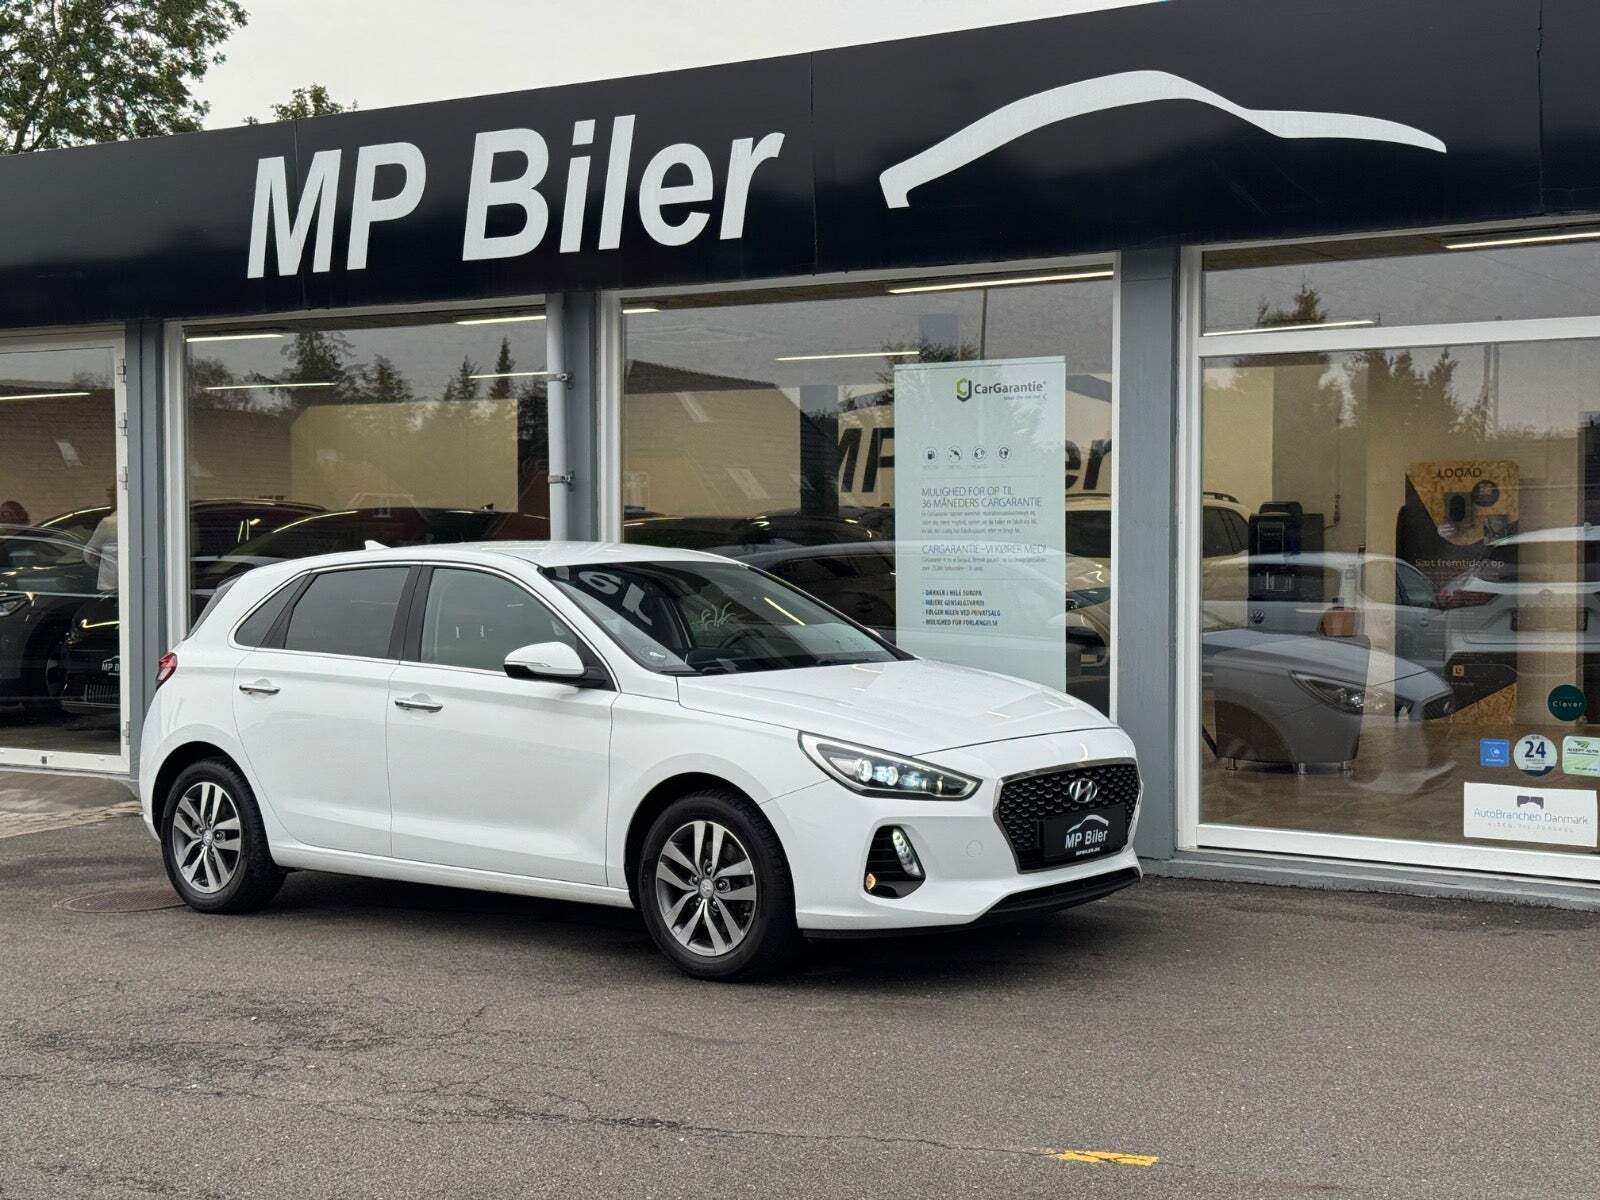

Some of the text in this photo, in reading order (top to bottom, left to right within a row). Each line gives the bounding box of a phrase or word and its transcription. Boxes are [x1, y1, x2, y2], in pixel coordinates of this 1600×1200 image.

[247, 114, 785, 279] MP Biler
[974, 381, 1045, 395] CarGarantie
[921, 486, 1014, 497] MULIGHED FOR OP TIL
[921, 497, 1042, 509] 36 MÅNEDERS CARGARANTIE
[1524, 741, 1546, 758] 24
[1474, 807, 1588, 825] AutoBranchen Danmark
[1065, 828, 1108, 849] MP Biler
